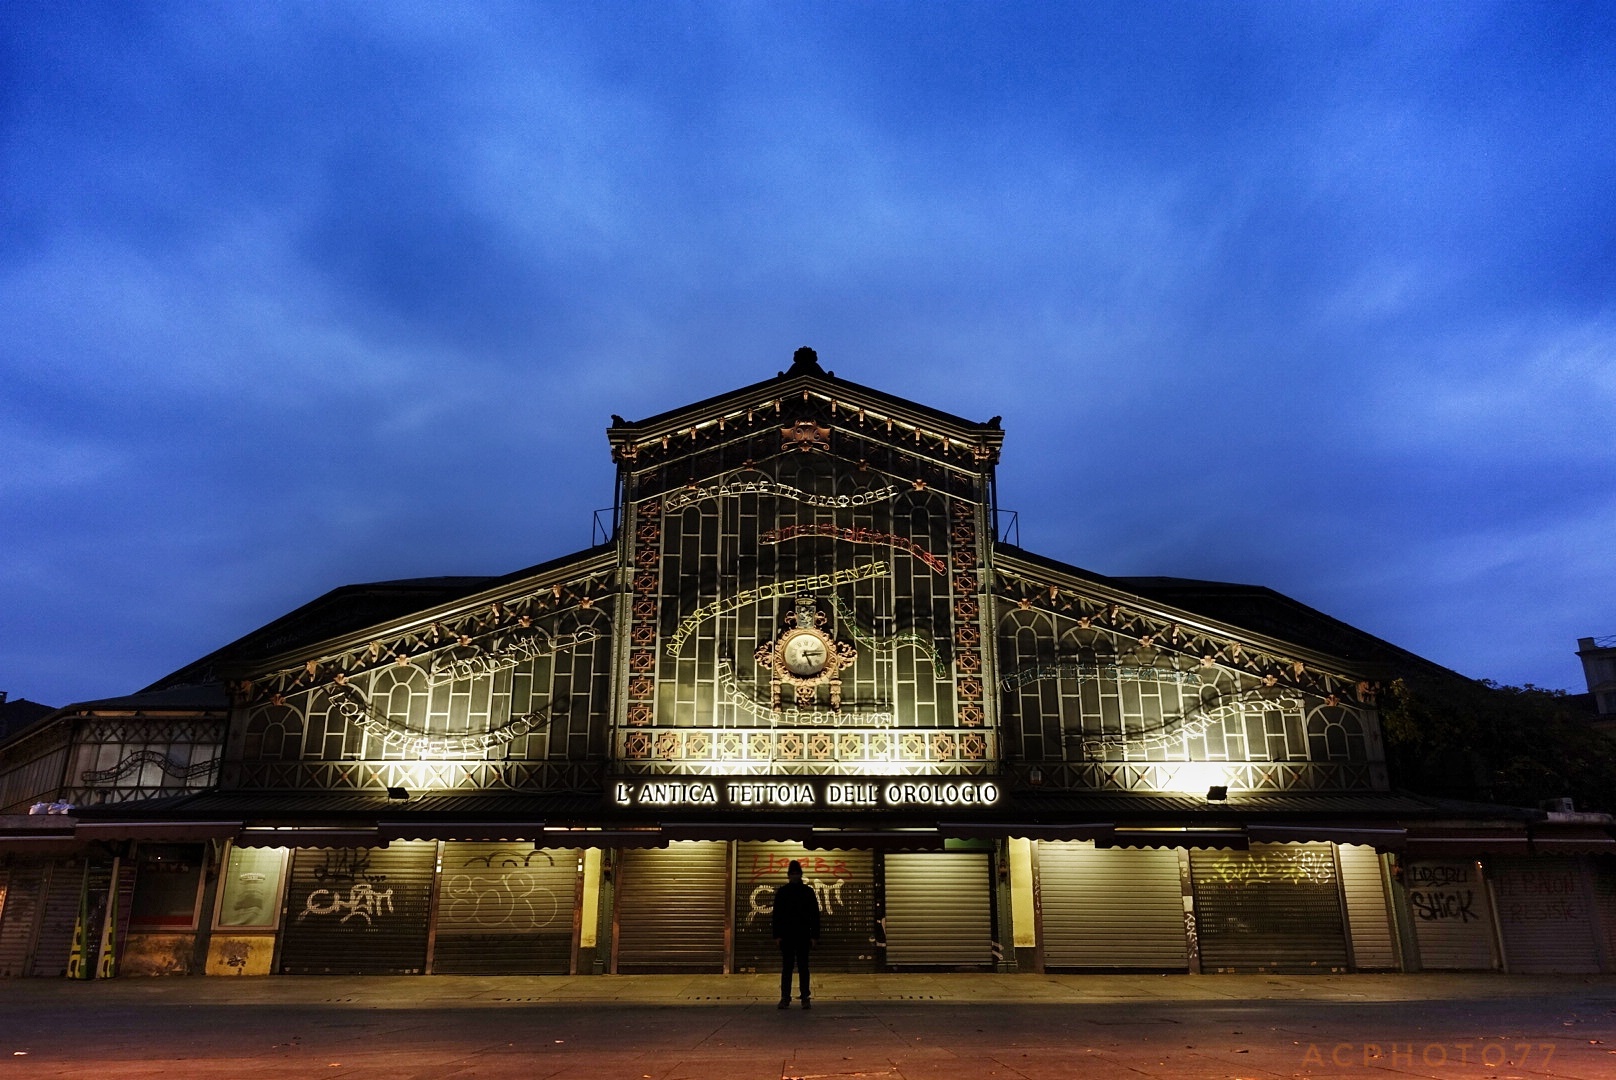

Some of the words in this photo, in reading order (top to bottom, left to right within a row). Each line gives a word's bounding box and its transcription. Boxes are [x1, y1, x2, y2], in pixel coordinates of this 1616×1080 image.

[807, 485, 899, 507] ΔΙΑΦΟΡΕΣ
[665, 600, 722, 658] AMARE
[726, 589, 754, 610] LE
[758, 561, 888, 599] DIFFERENZE
[327, 692, 387, 736] LOVE
[638, 783, 718, 804] ANTICA
[727, 784, 815, 804] TETTOIA
[829, 783, 880, 804] DELL'
[887, 783, 999, 804] OROLOGIO
